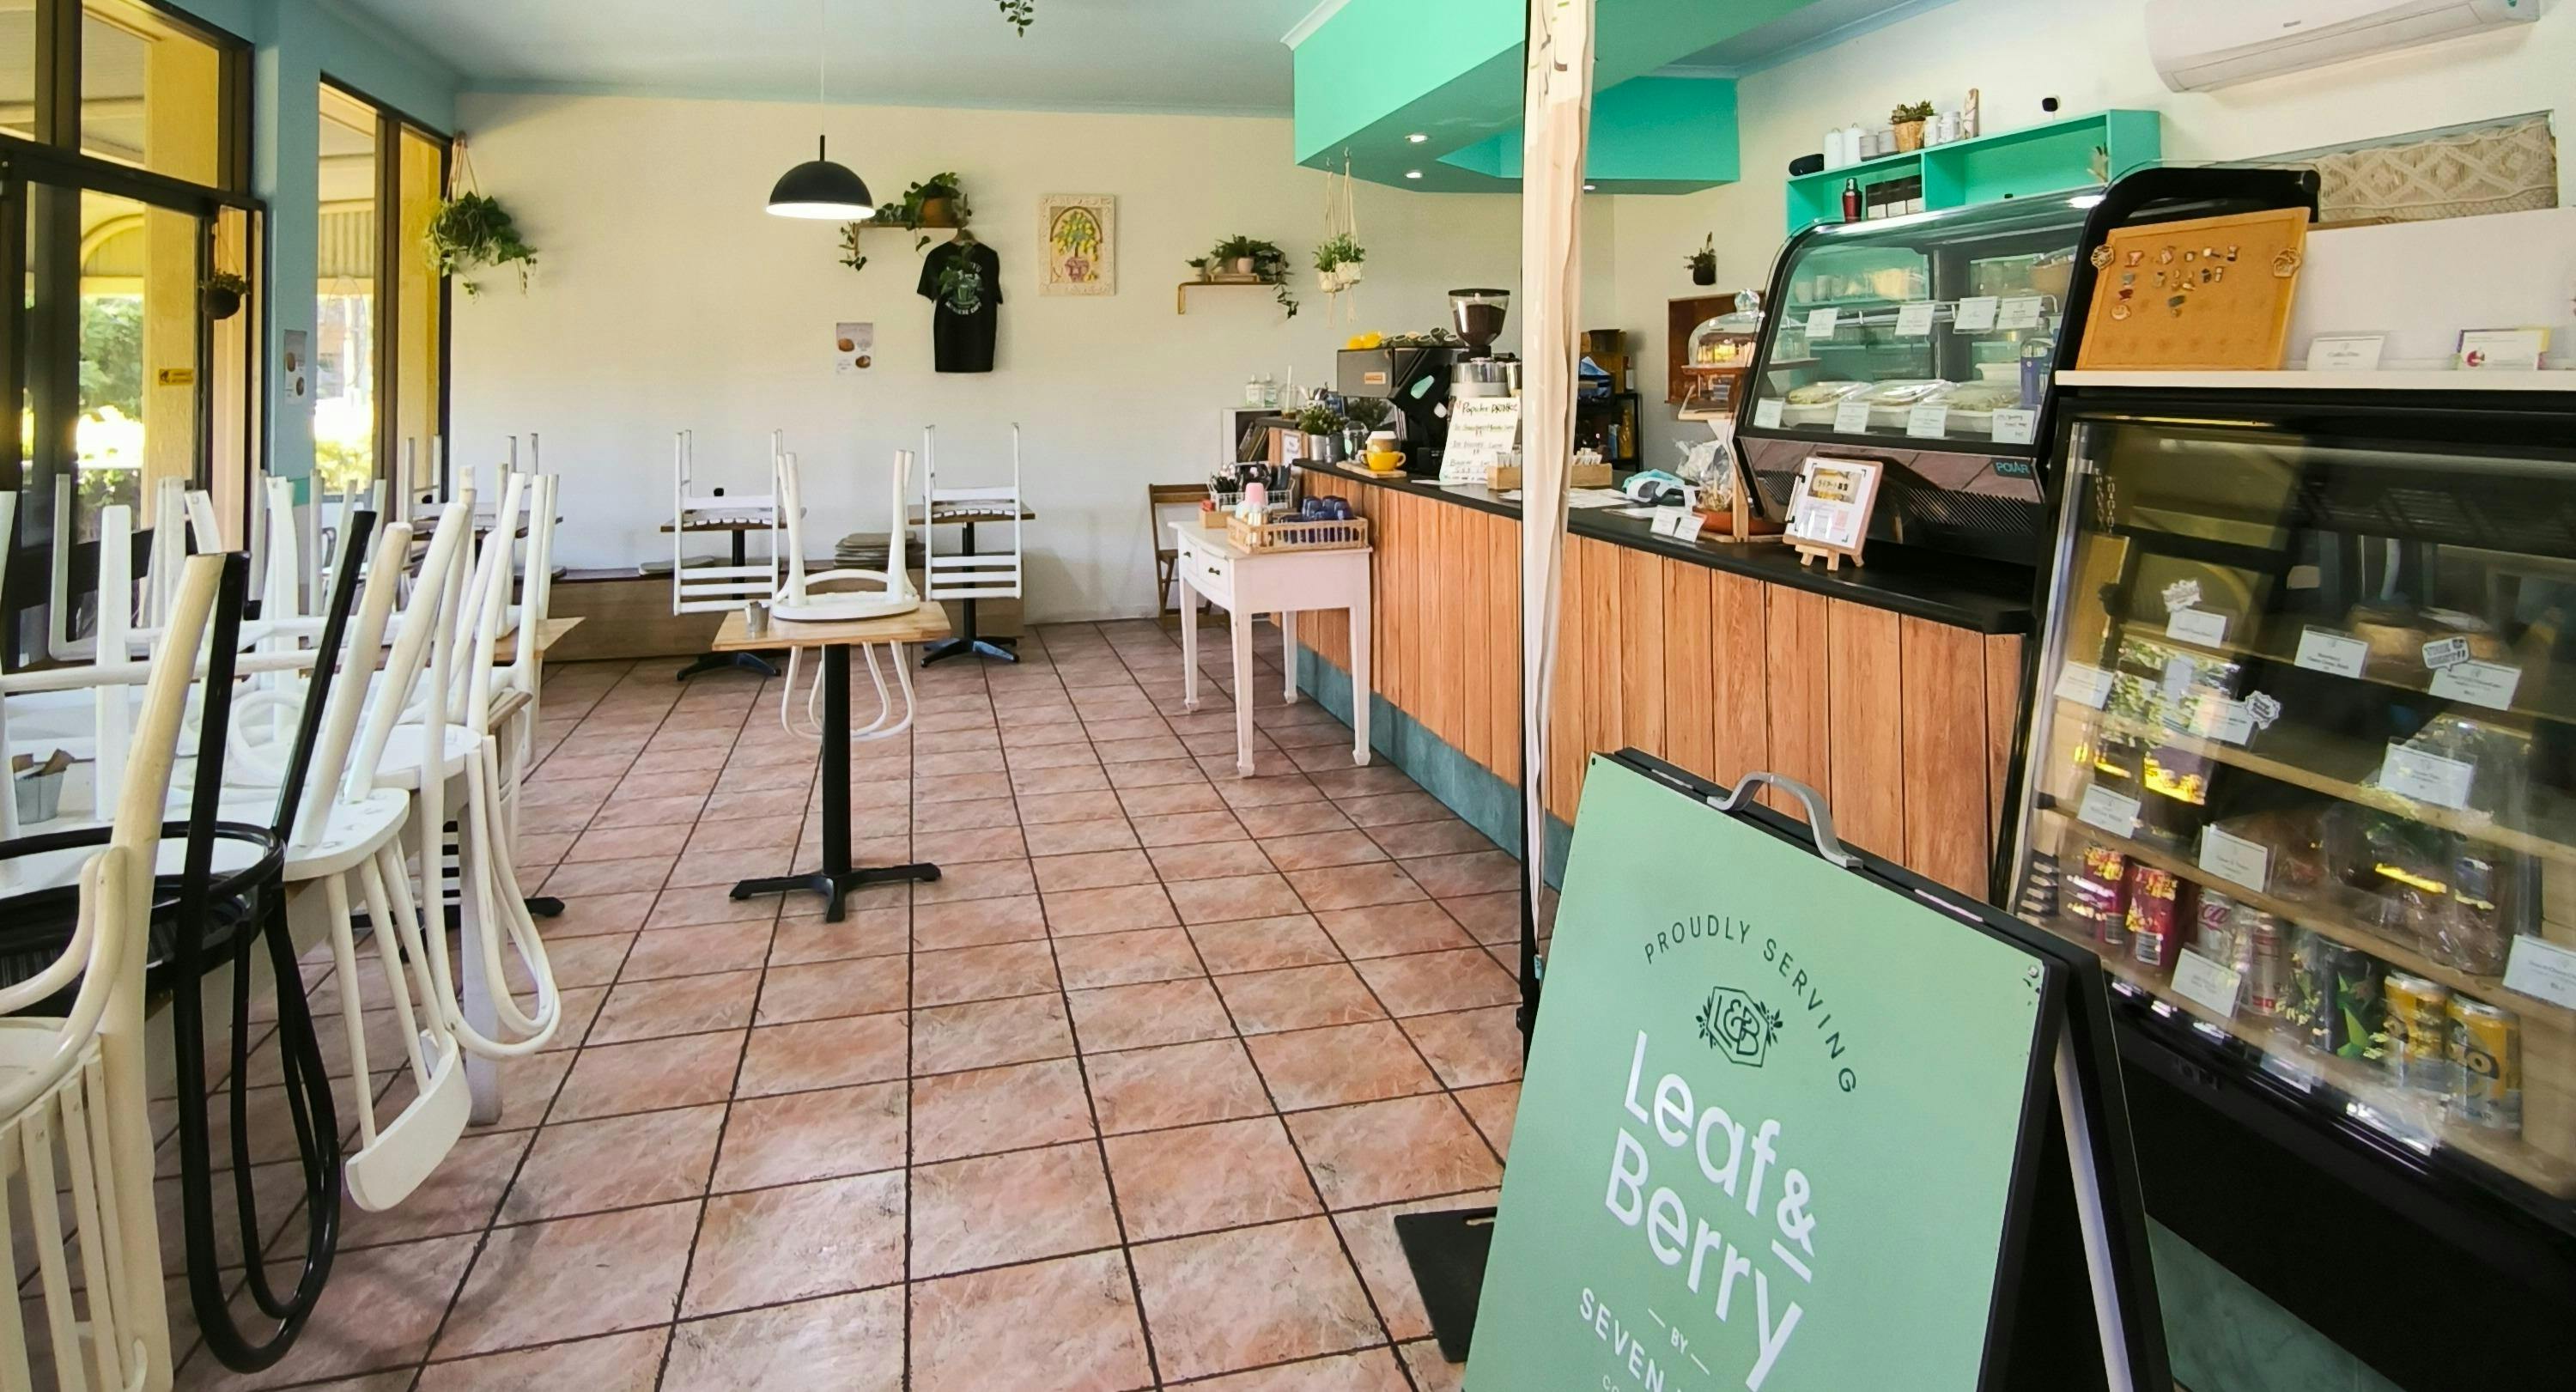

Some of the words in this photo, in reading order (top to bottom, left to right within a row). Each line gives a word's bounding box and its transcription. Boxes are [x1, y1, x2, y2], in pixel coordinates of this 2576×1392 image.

[1996, 460, 2030, 474] POLAR
[1643, 914, 1751, 965] PROUDLY
[1763, 938, 1856, 1092] SERVING
[1624, 1029, 1782, 1218] Leaf
[1777, 1168, 1817, 1259] &
[1605, 1127, 1804, 1392] Berry
[1579, 1286, 1664, 1392] SEVEN
[1670, 1326, 1688, 1354] BY
